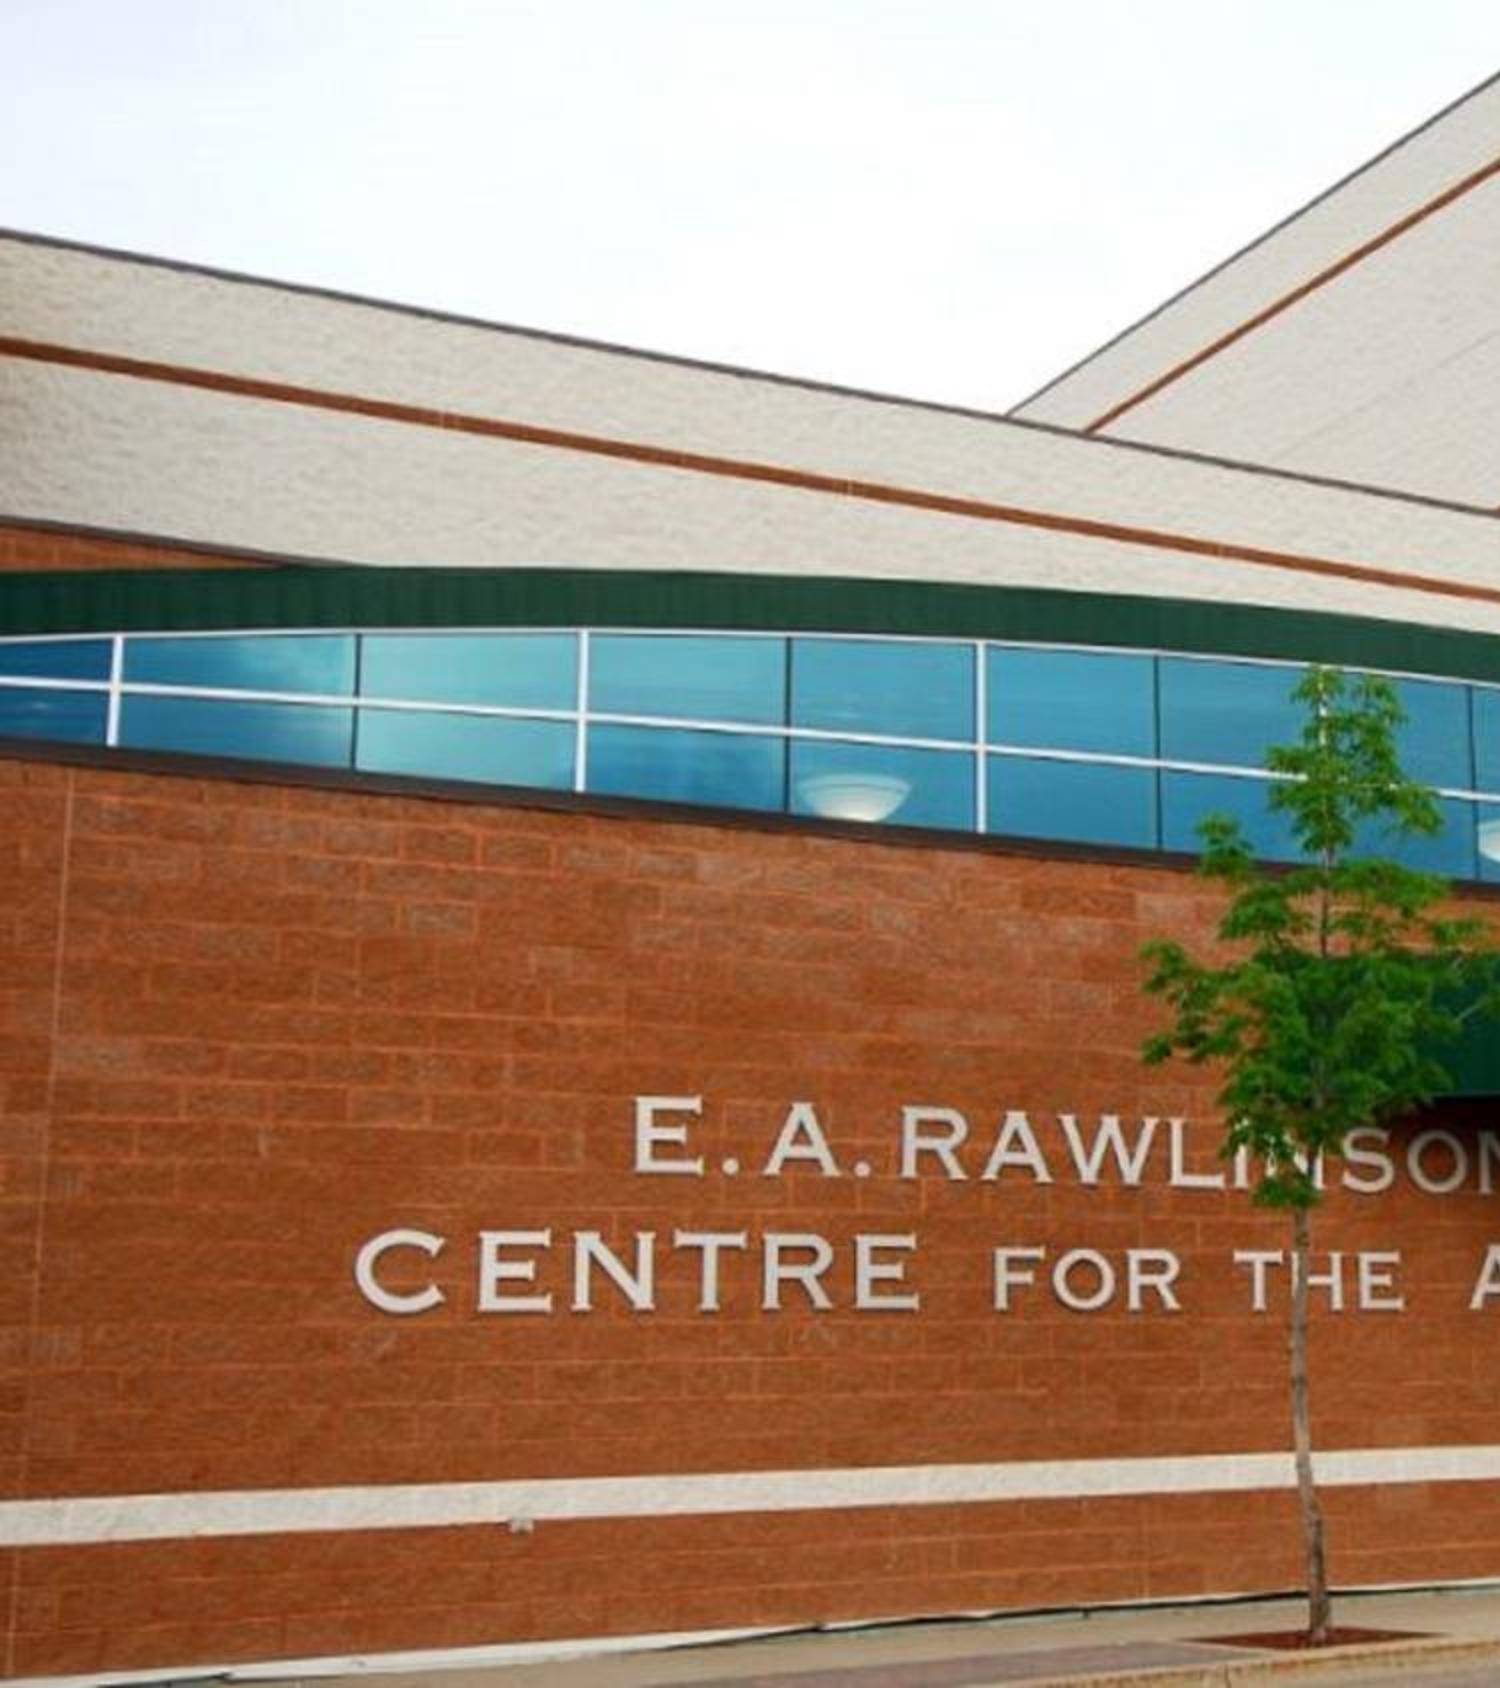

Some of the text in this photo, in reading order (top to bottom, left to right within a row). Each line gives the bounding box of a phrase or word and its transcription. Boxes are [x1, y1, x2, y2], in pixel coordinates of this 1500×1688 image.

[353, 1227, 920, 1315] CENTRE
[992, 1246, 1183, 1312] FOR
[1233, 1249, 1407, 1312] THE
